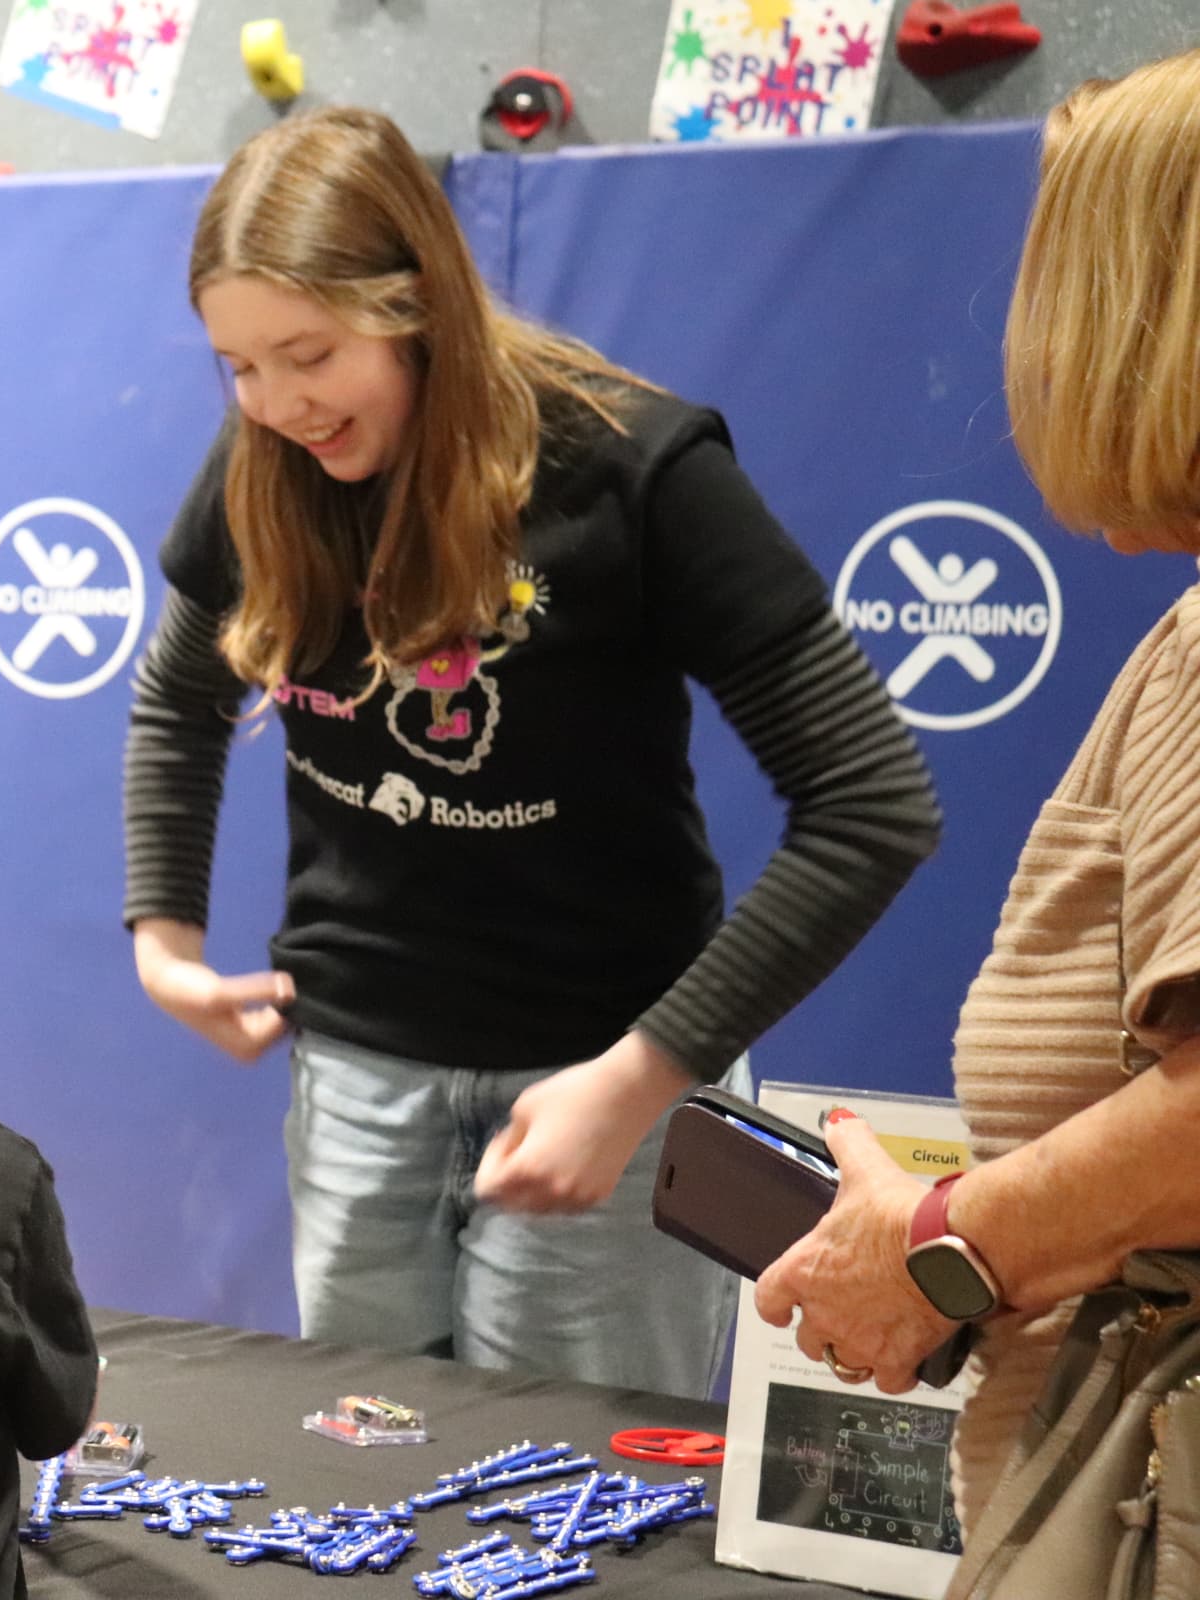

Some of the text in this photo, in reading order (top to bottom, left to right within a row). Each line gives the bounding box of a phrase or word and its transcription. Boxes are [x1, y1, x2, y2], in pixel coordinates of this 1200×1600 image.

[710, 51, 845, 93] SPLAT
[703, 91, 832, 133] POINT
[845, 599, 1049, 637] NO CLIMBING
[429, 797, 557, 829] Robotics
[912, 1149, 961, 1166] Circuit
[868, 1451, 930, 1485] Simple
[863, 1479, 927, 1513] Circuit
